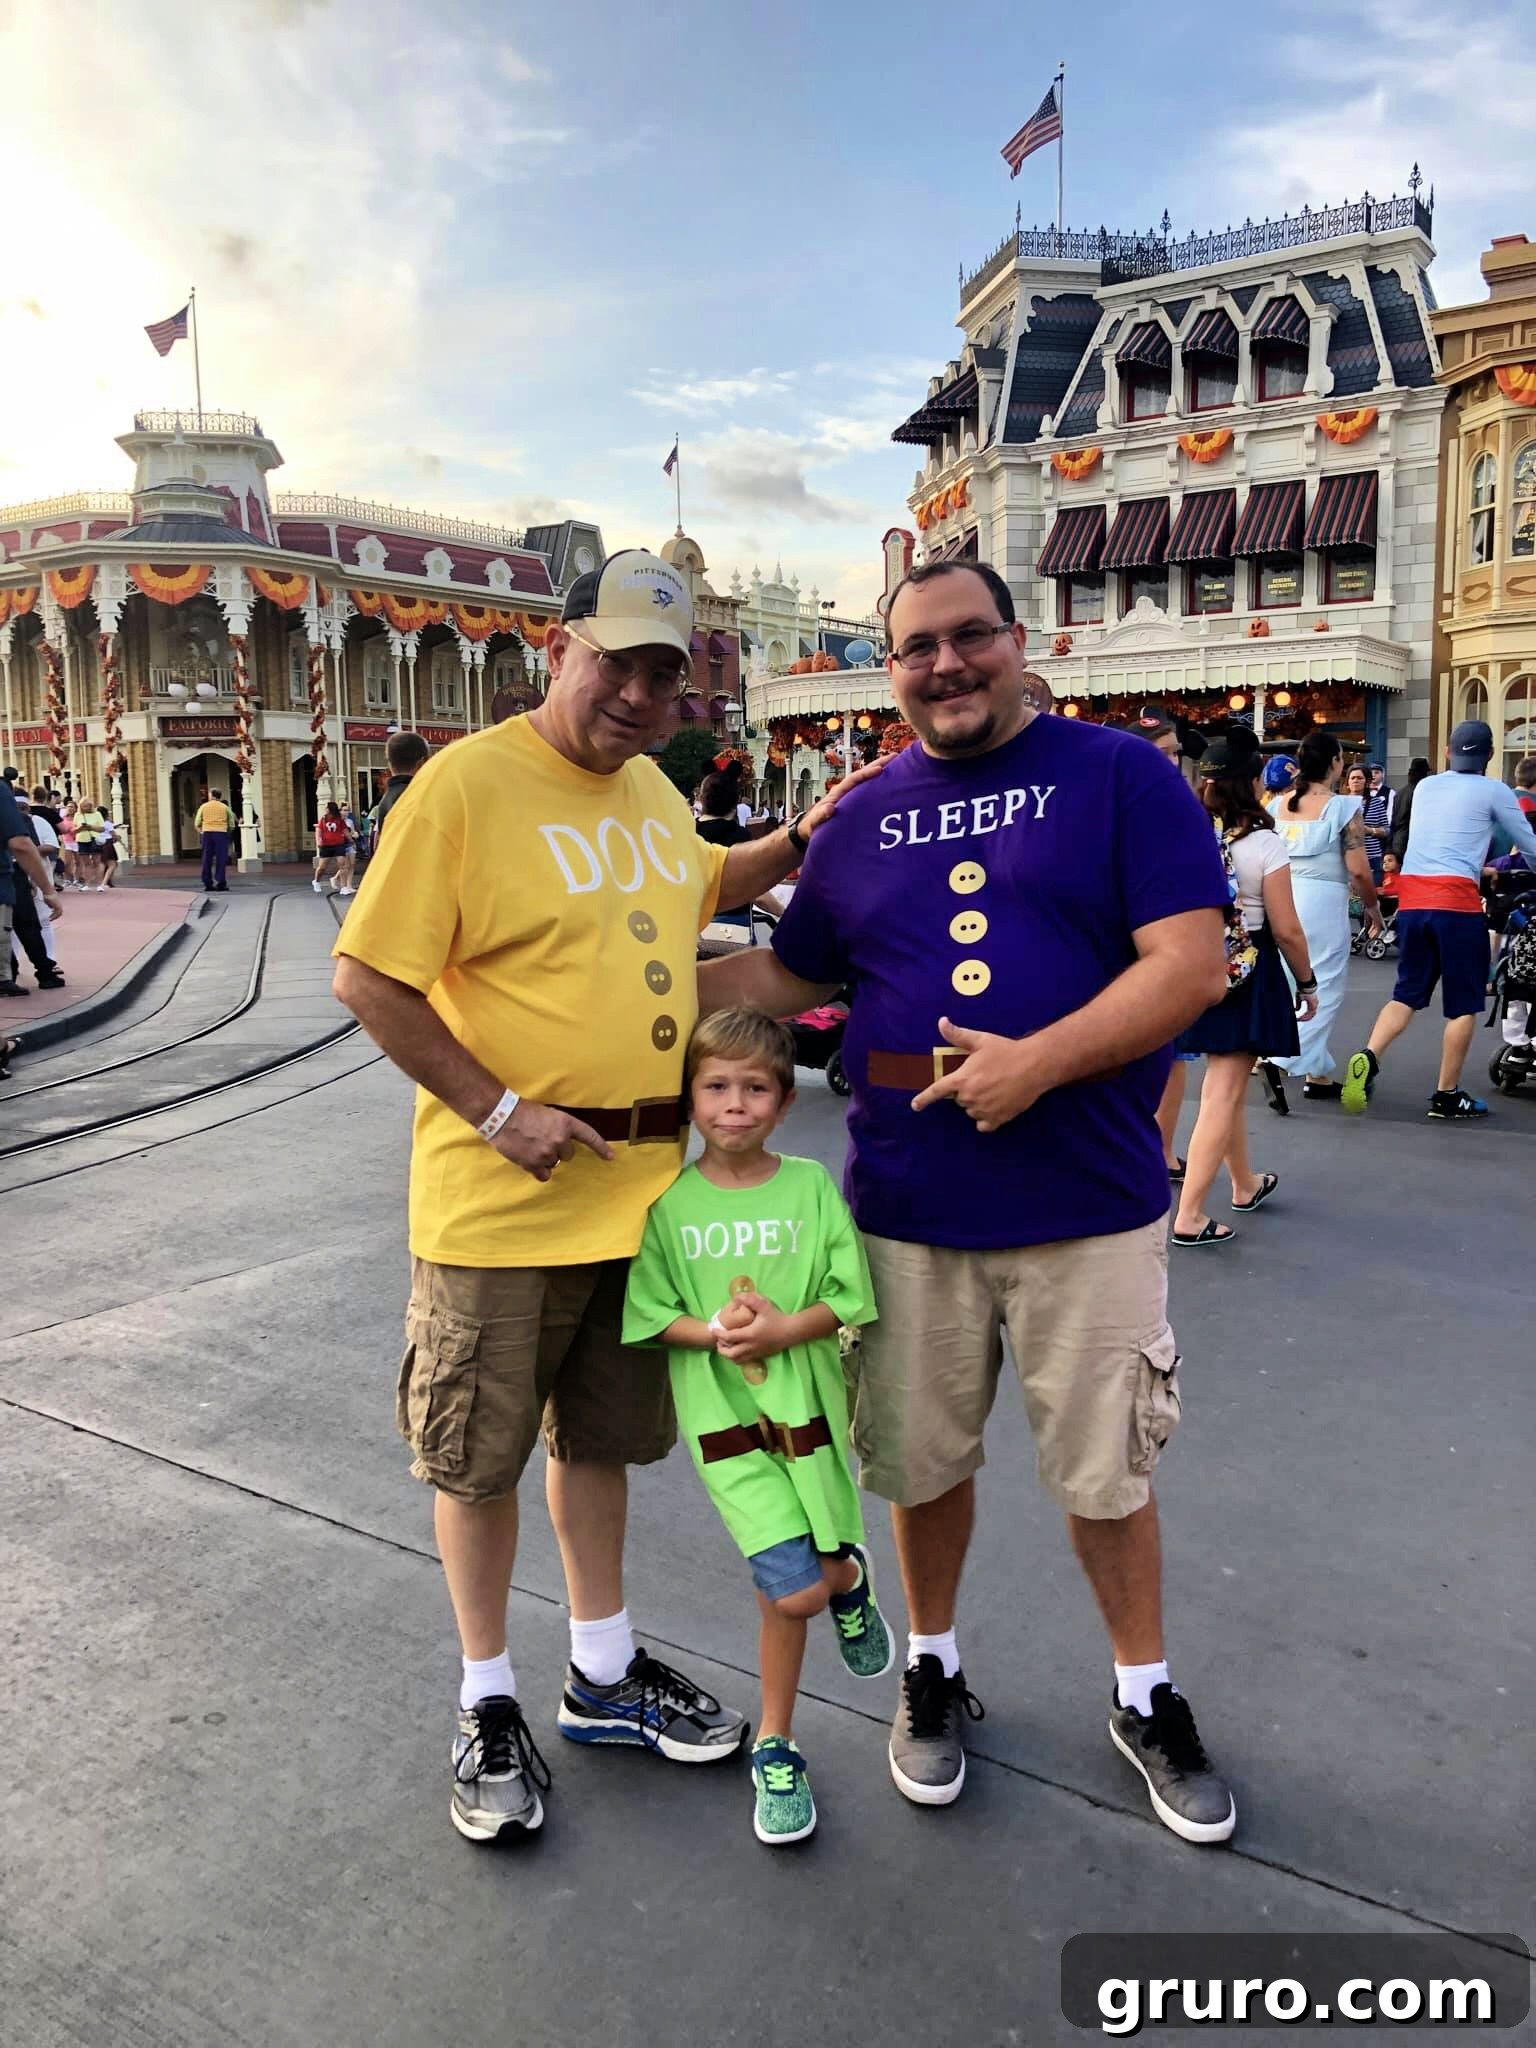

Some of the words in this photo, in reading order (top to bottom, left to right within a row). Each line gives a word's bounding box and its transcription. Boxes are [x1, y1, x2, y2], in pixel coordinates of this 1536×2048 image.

[880, 786, 1056, 850] SLEEPY
[538, 817, 687, 894] DOC
[680, 1219, 803, 1260] DOPEY
